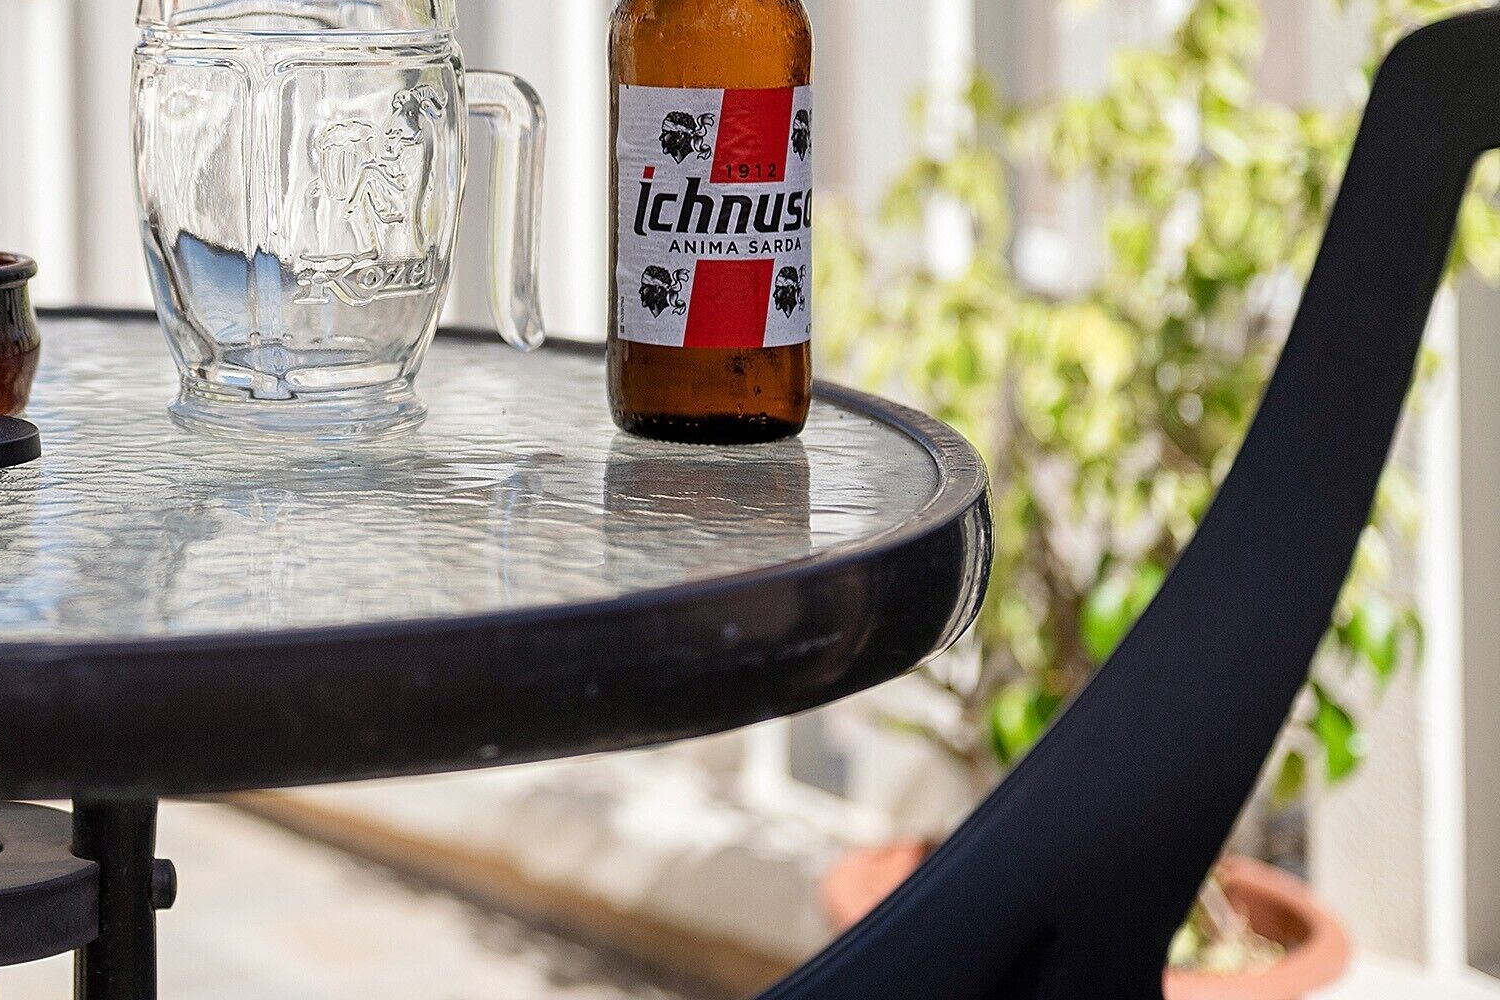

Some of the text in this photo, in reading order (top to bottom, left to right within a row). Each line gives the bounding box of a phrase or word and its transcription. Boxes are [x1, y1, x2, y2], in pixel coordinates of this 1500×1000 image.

[724, 163, 778, 178] 1912
[668, 238, 802, 255] ANIMA SARDA
[294, 245, 437, 307] Kozel
